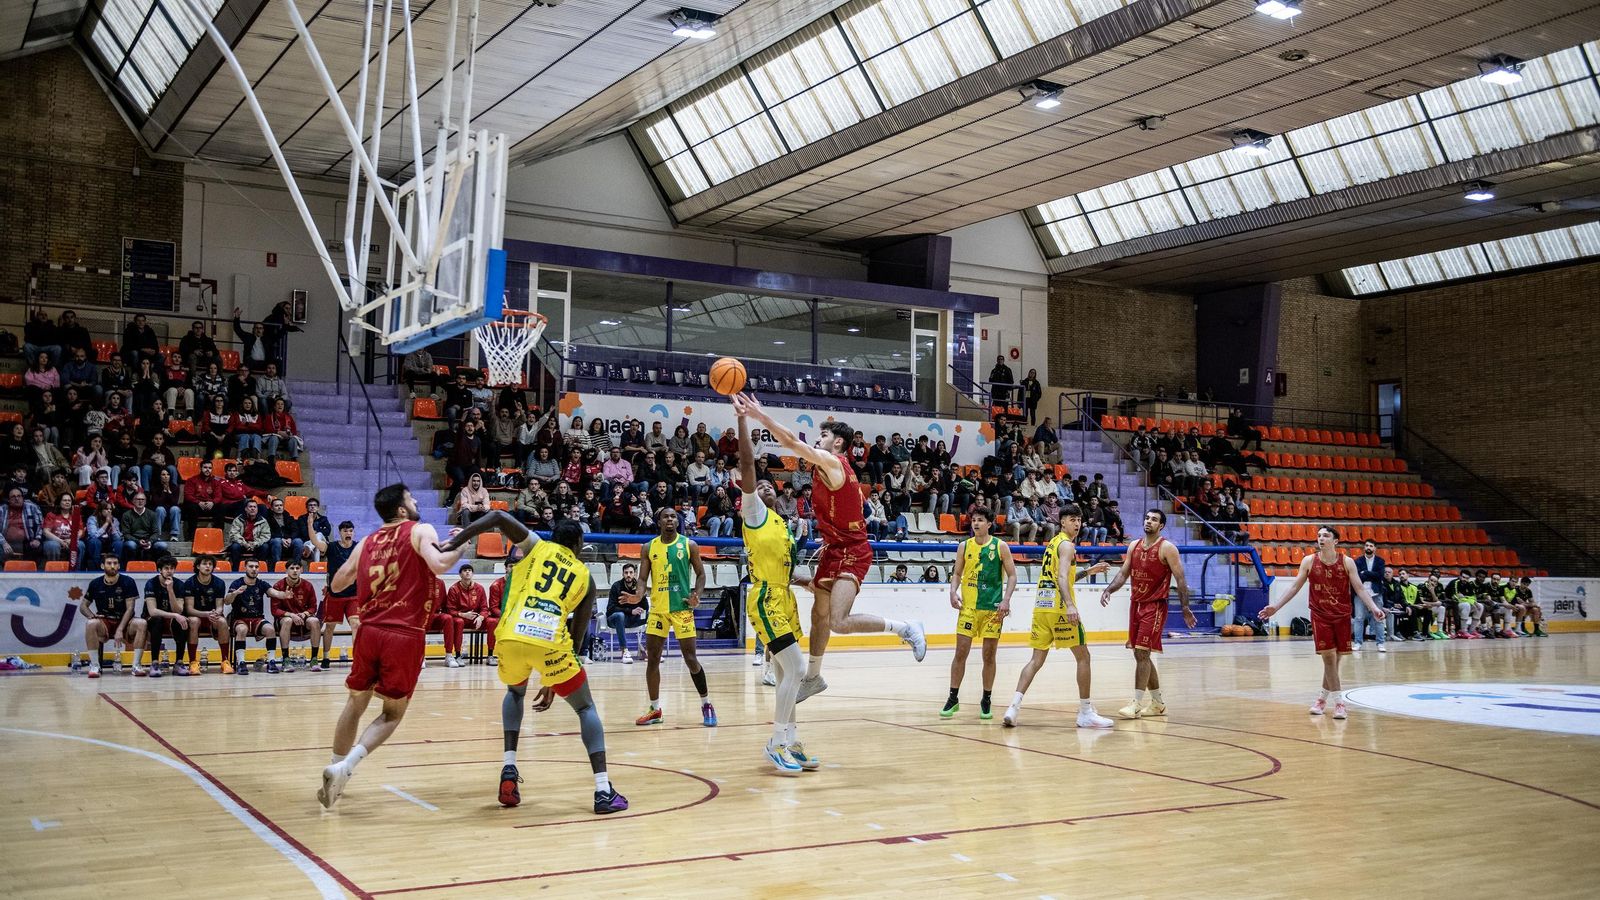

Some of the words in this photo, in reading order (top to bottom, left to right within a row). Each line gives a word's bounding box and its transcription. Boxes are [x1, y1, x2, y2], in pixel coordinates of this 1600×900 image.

[959, 341, 967, 354] A
[1265, 372, 1272, 383] A
[368, 561, 400, 597] 22
[535, 560, 576, 600] 34
